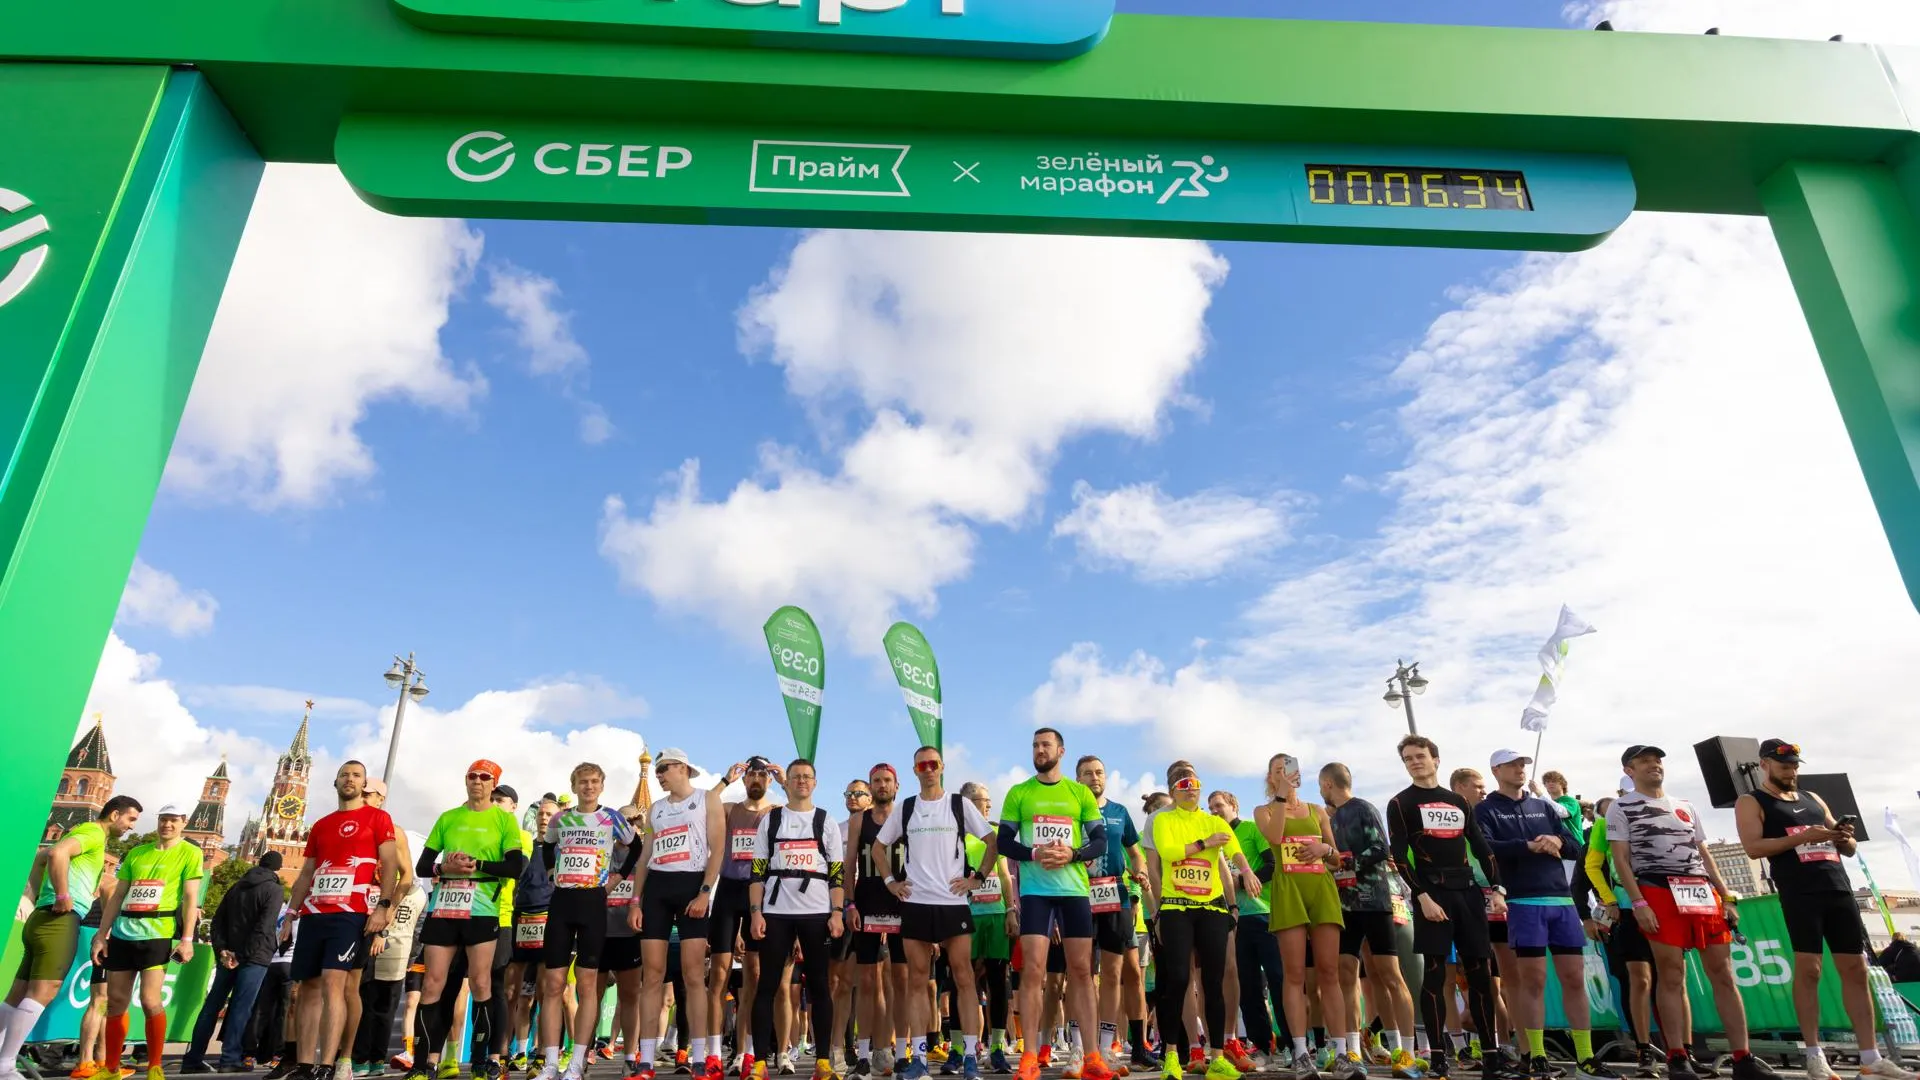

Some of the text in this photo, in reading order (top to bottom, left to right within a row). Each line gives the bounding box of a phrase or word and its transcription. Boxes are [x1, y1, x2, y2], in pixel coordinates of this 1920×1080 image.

[533, 142, 693, 178] СБЕР
[1036, 152, 1164, 174] зелёный
[771, 155, 880, 181] Прайм
[1020, 173, 1155, 198] марафон
[1427, 811, 1459, 823] 9945
[567, 830, 596, 838] РИТМЕ
[1035, 826, 1071, 839] 10949
[575, 837, 598, 845] 2ГИС
[655, 834, 687, 851] 11027
[563, 857, 590, 868] 9036
[785, 854, 813, 866] 7390
[1174, 868, 1210, 881] 10819
[318, 877, 348, 889] 8127
[131, 888, 157, 898] 8668
[440, 891, 472, 903] 10070
[1091, 886, 1116, 898] 1261
[1676, 887, 1708, 899] 7743
[521, 925, 544, 936] 9431
[1729, 939, 1793, 987] 85
